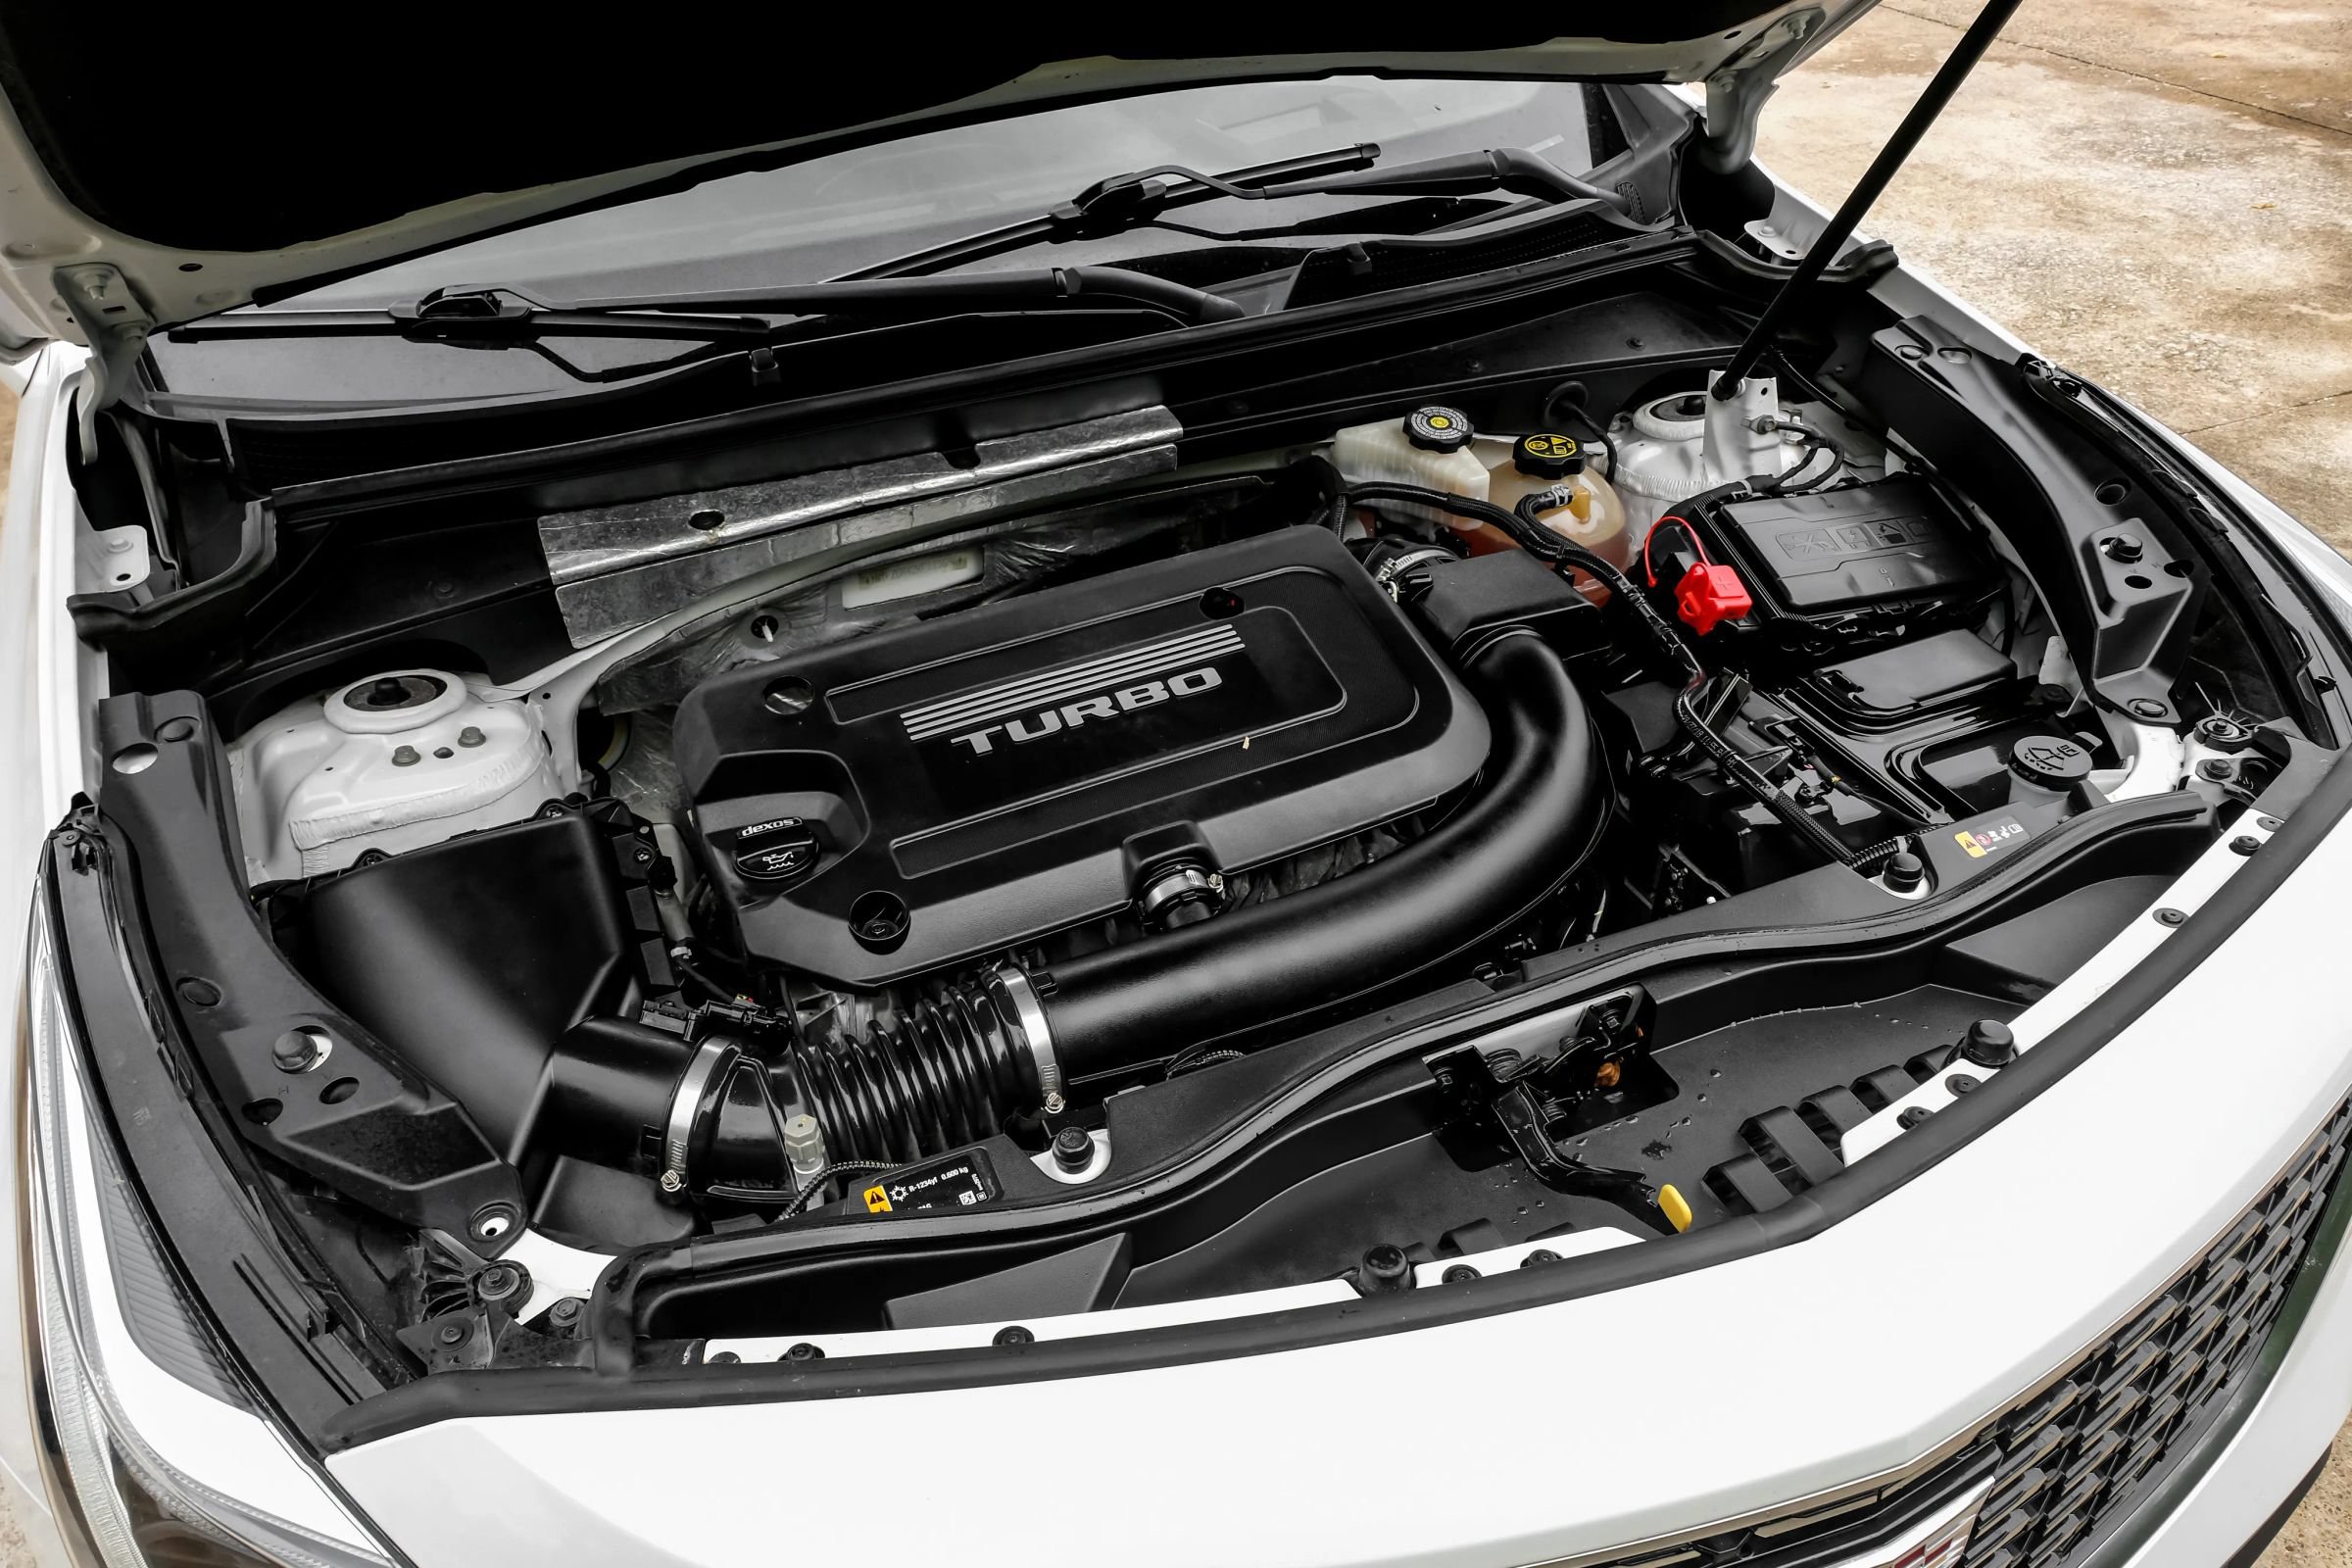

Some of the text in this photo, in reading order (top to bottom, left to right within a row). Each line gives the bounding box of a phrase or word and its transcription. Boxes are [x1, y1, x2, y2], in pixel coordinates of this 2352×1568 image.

[951, 666, 1223, 755] TURBO
[742, 818, 794, 837] dexos
[908, 1176, 938, 1193] R-1234yf
